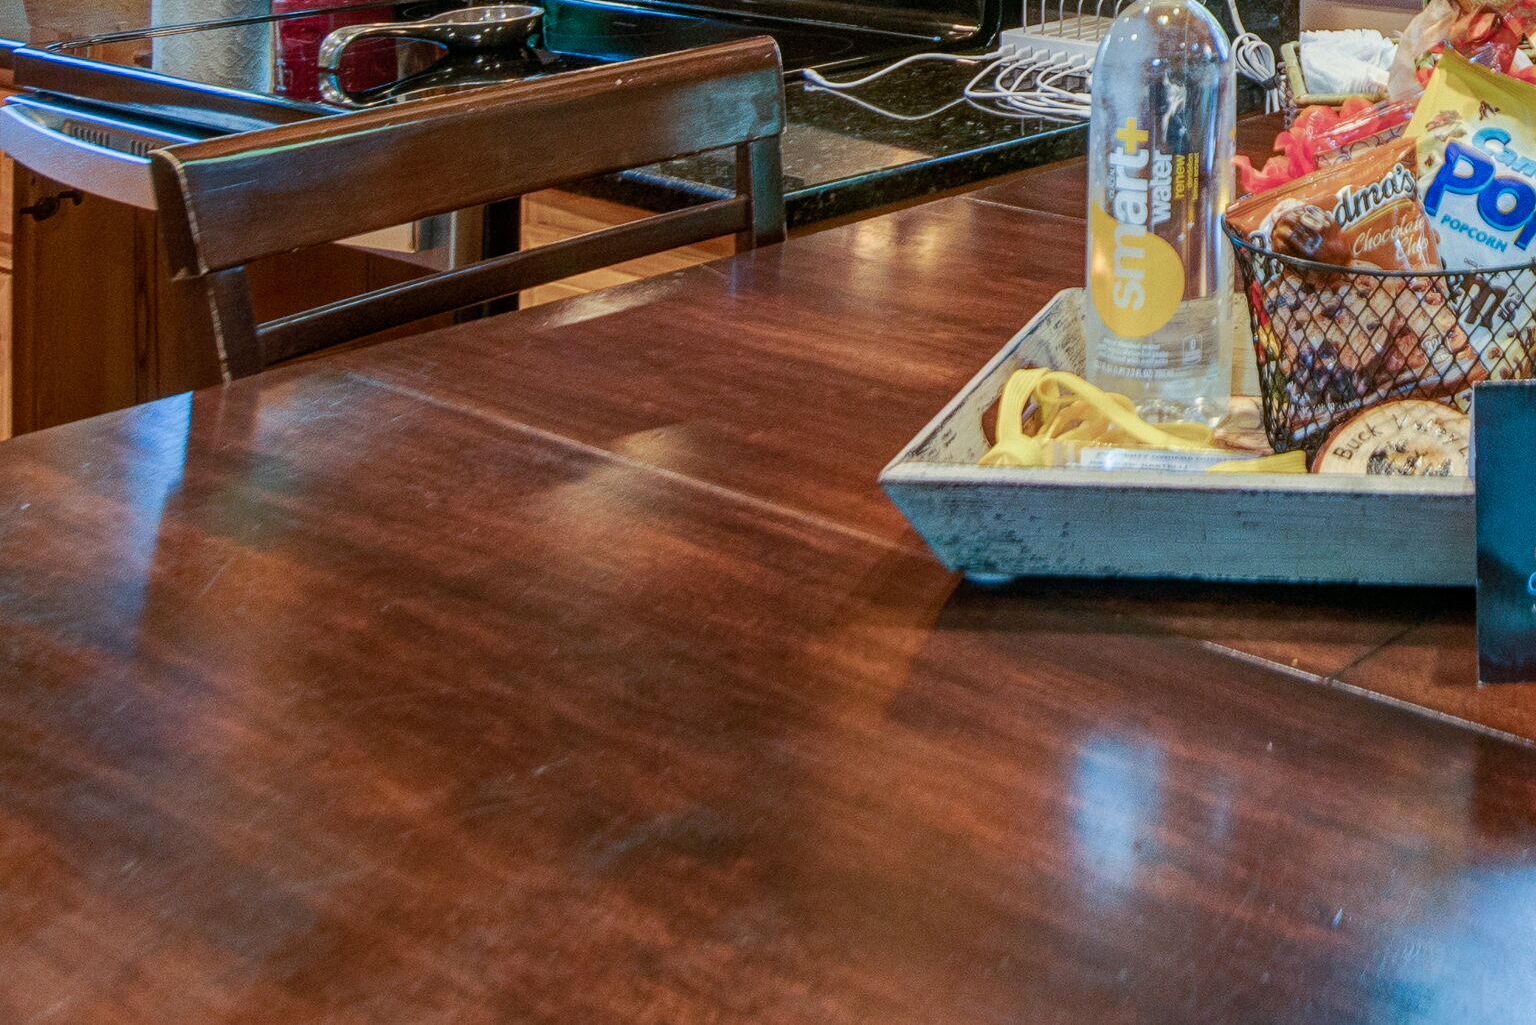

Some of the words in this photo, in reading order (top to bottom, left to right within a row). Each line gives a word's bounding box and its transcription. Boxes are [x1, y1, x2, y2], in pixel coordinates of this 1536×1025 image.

[1150, 150, 1172, 225] water
[1174, 154, 1186, 199] renew
[1353, 214, 1426, 256] Chocolate
[1399, 232, 1429, 256] Chip
[1440, 213, 1508, 253] POPCORN
[1332, 423, 1382, 461] Buck
